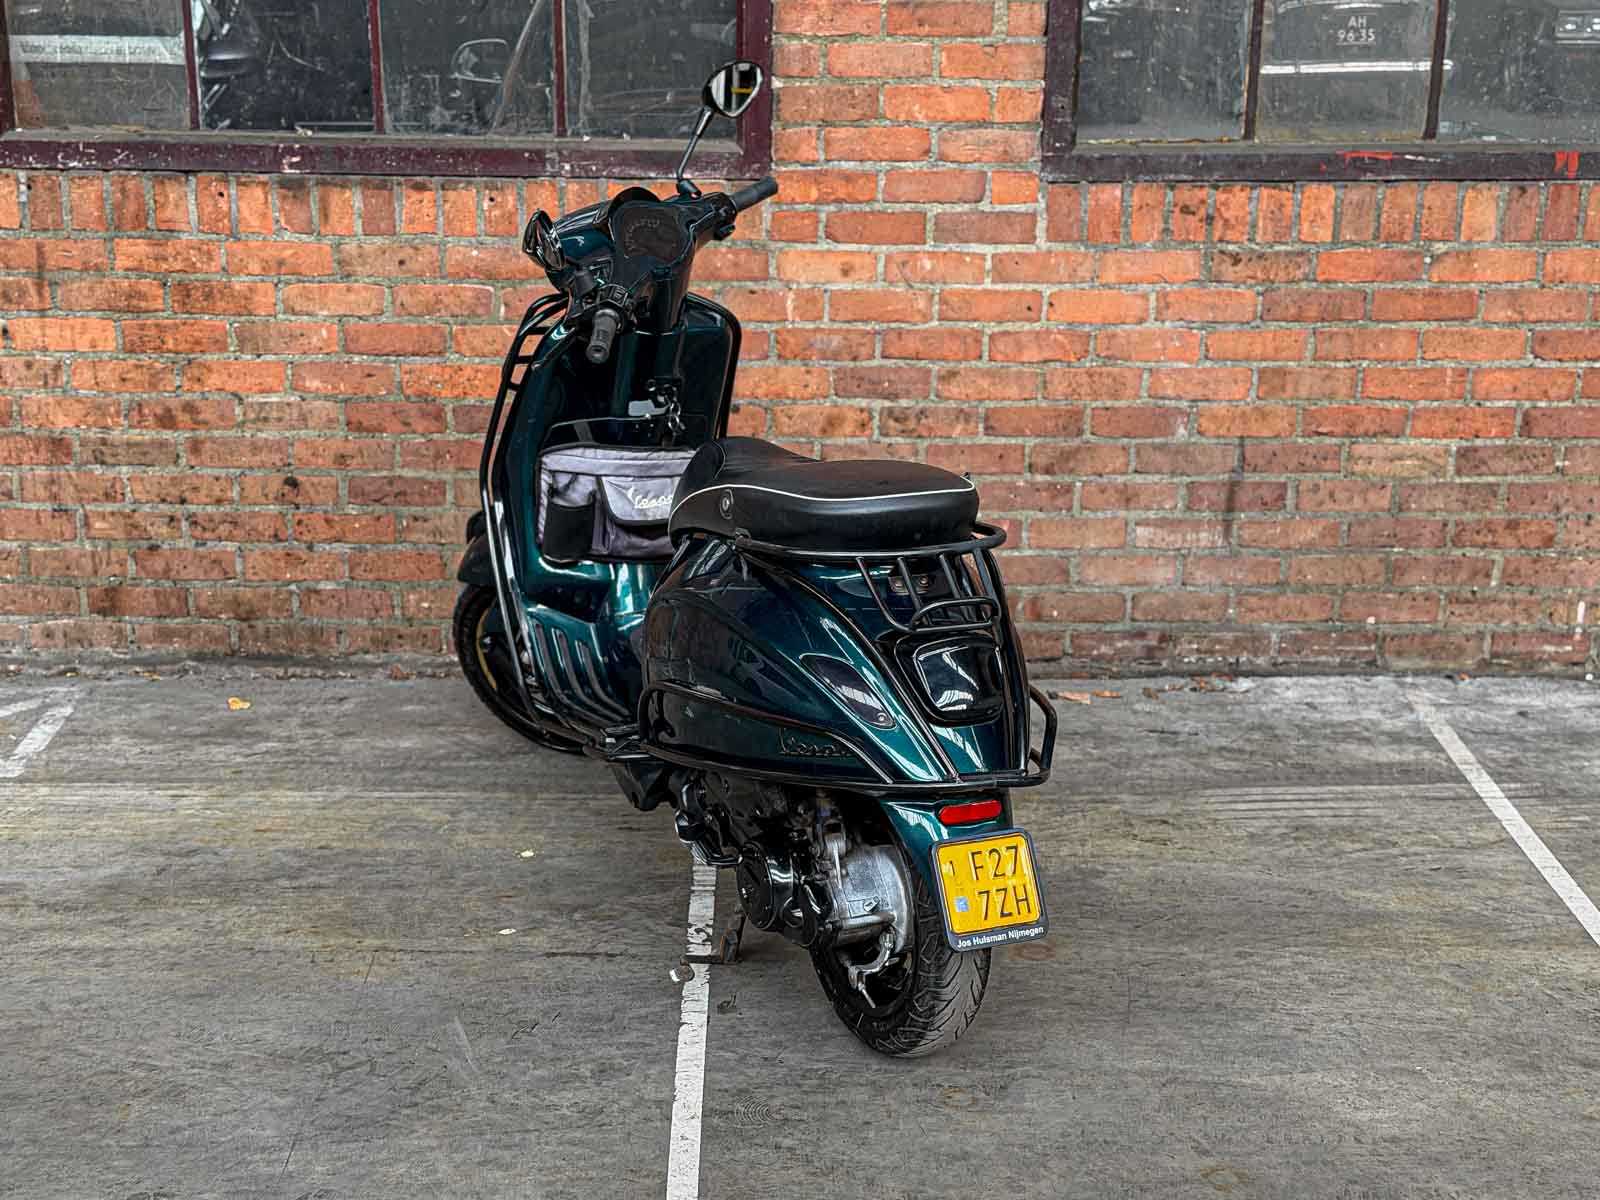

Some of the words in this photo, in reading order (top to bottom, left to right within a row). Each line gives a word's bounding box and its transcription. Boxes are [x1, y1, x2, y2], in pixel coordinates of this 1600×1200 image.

[1348, 16, 1367, 28] AH
[971, 845, 1019, 881] F27
[977, 884, 1032, 921] 7ZH
[957, 939, 972, 948] Jos
[973, 933, 1007, 945] Huisman
[1008, 926, 1044, 940] Nijmegen
